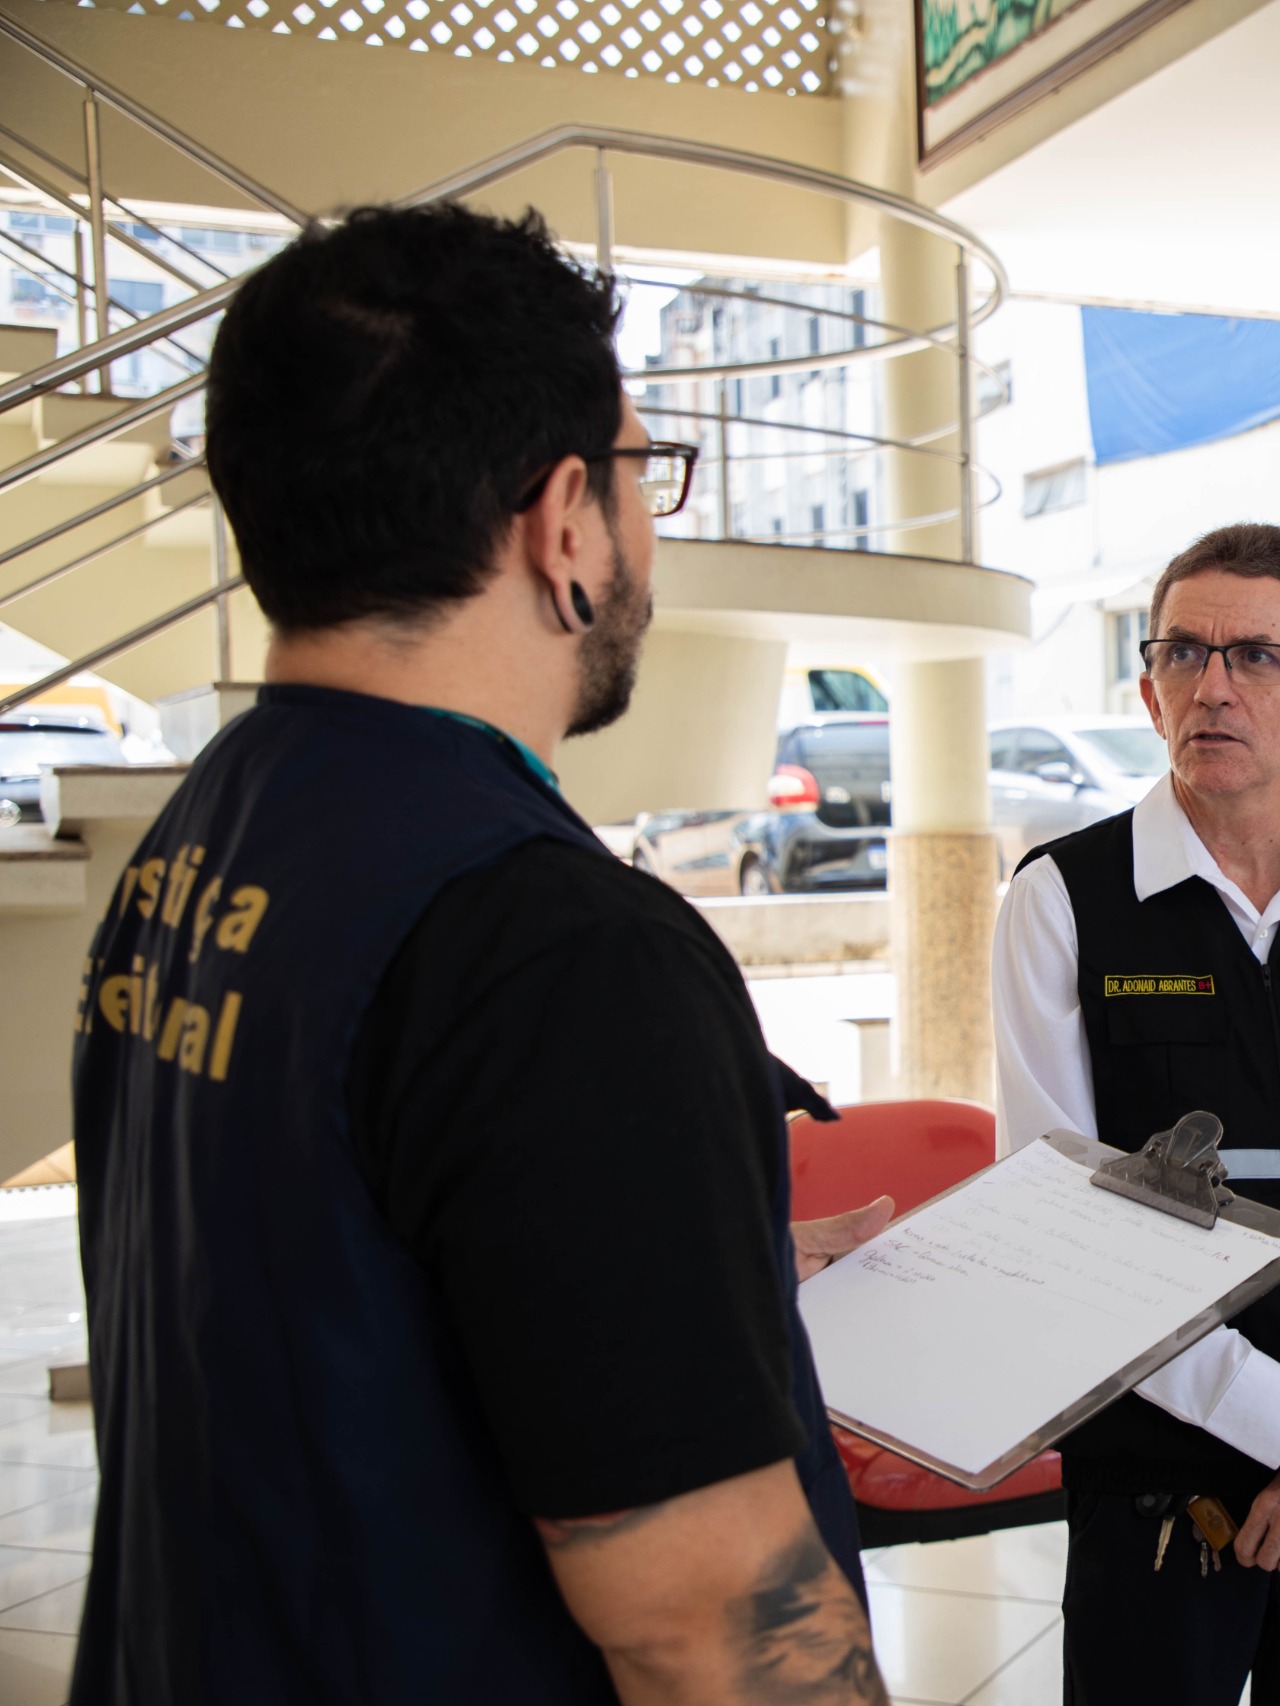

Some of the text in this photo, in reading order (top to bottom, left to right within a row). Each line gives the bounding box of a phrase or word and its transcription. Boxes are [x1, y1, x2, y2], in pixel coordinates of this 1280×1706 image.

[1108, 980, 1121, 993] DR.
[1122, 979, 1156, 992] ADONAID
[1159, 979, 1197, 992] ABRANTES
